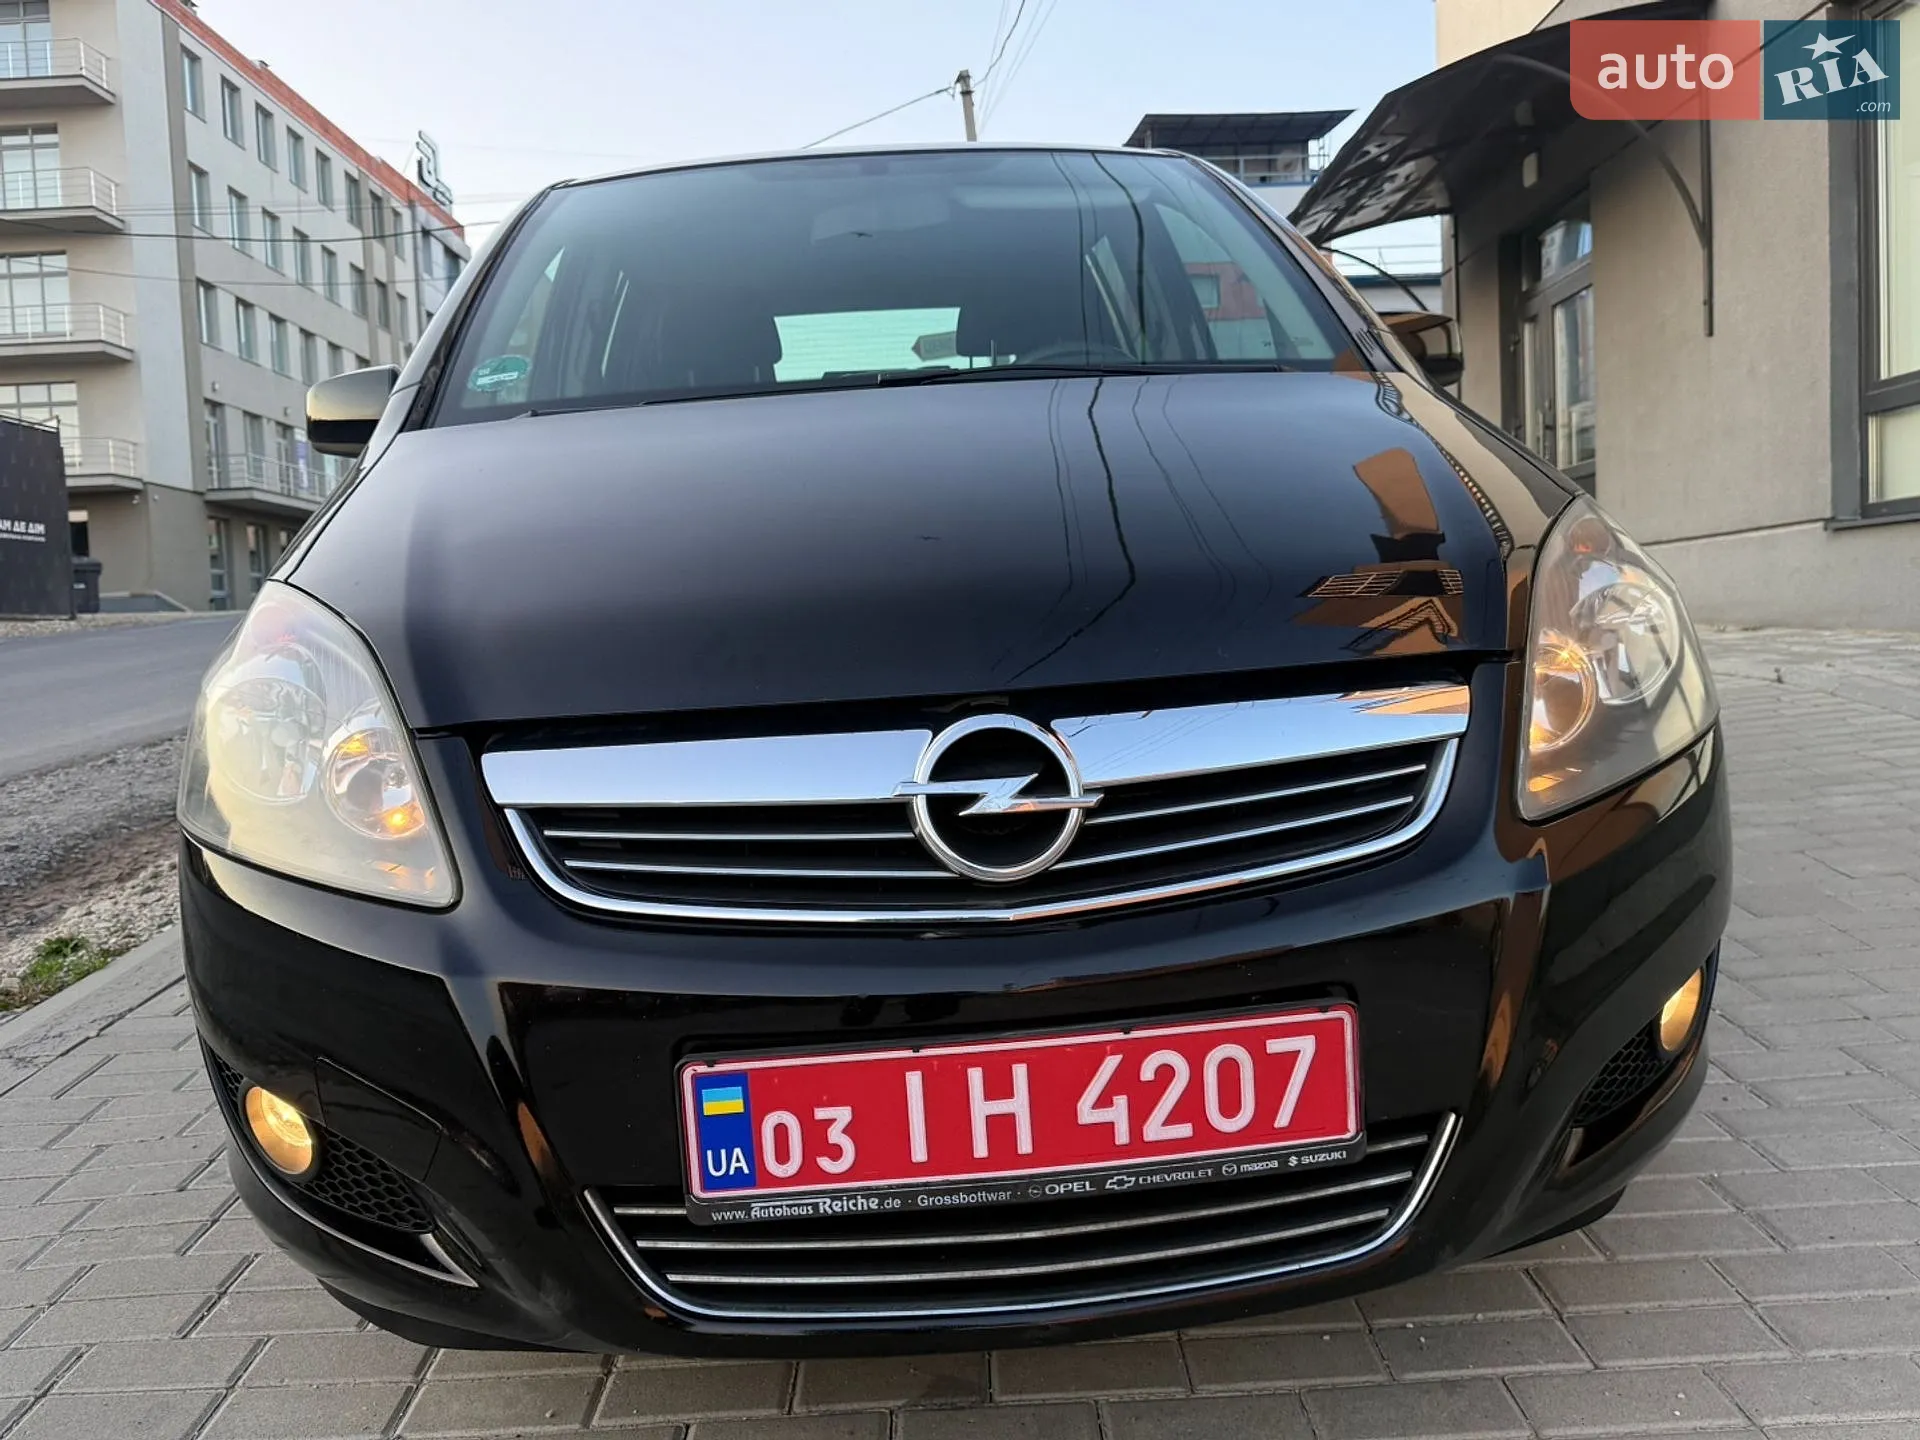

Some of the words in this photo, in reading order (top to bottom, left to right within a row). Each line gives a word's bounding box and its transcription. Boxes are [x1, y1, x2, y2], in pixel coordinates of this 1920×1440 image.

[760, 1105, 857, 1178] 03
[1077, 1034, 1317, 1146] 4207
[706, 1147, 750, 1178] UA
[917, 1189, 1013, 1208] Grossbottwar
[1045, 1180, 1096, 1196] OPEL
[1138, 1168, 1214, 1185] CHEVROLET
[1301, 1150, 1347, 1165] SUZUKI
